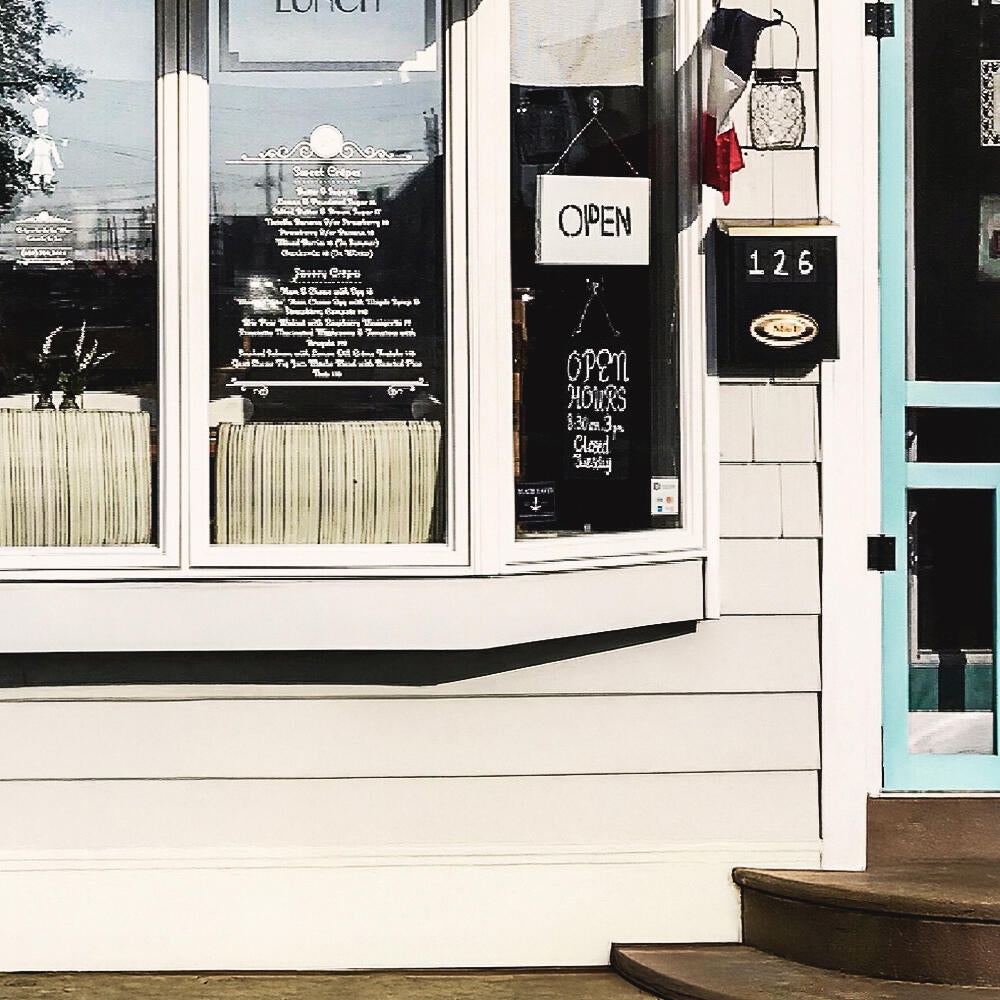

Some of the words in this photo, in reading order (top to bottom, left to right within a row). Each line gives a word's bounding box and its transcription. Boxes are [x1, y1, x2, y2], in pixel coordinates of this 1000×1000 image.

[292, 165, 325, 177] Sweet
[559, 204, 631, 237] OPEN
[749, 249, 814, 276] 126
[567, 348, 629, 382] OPEN
[567, 383, 627, 412] HOURS
